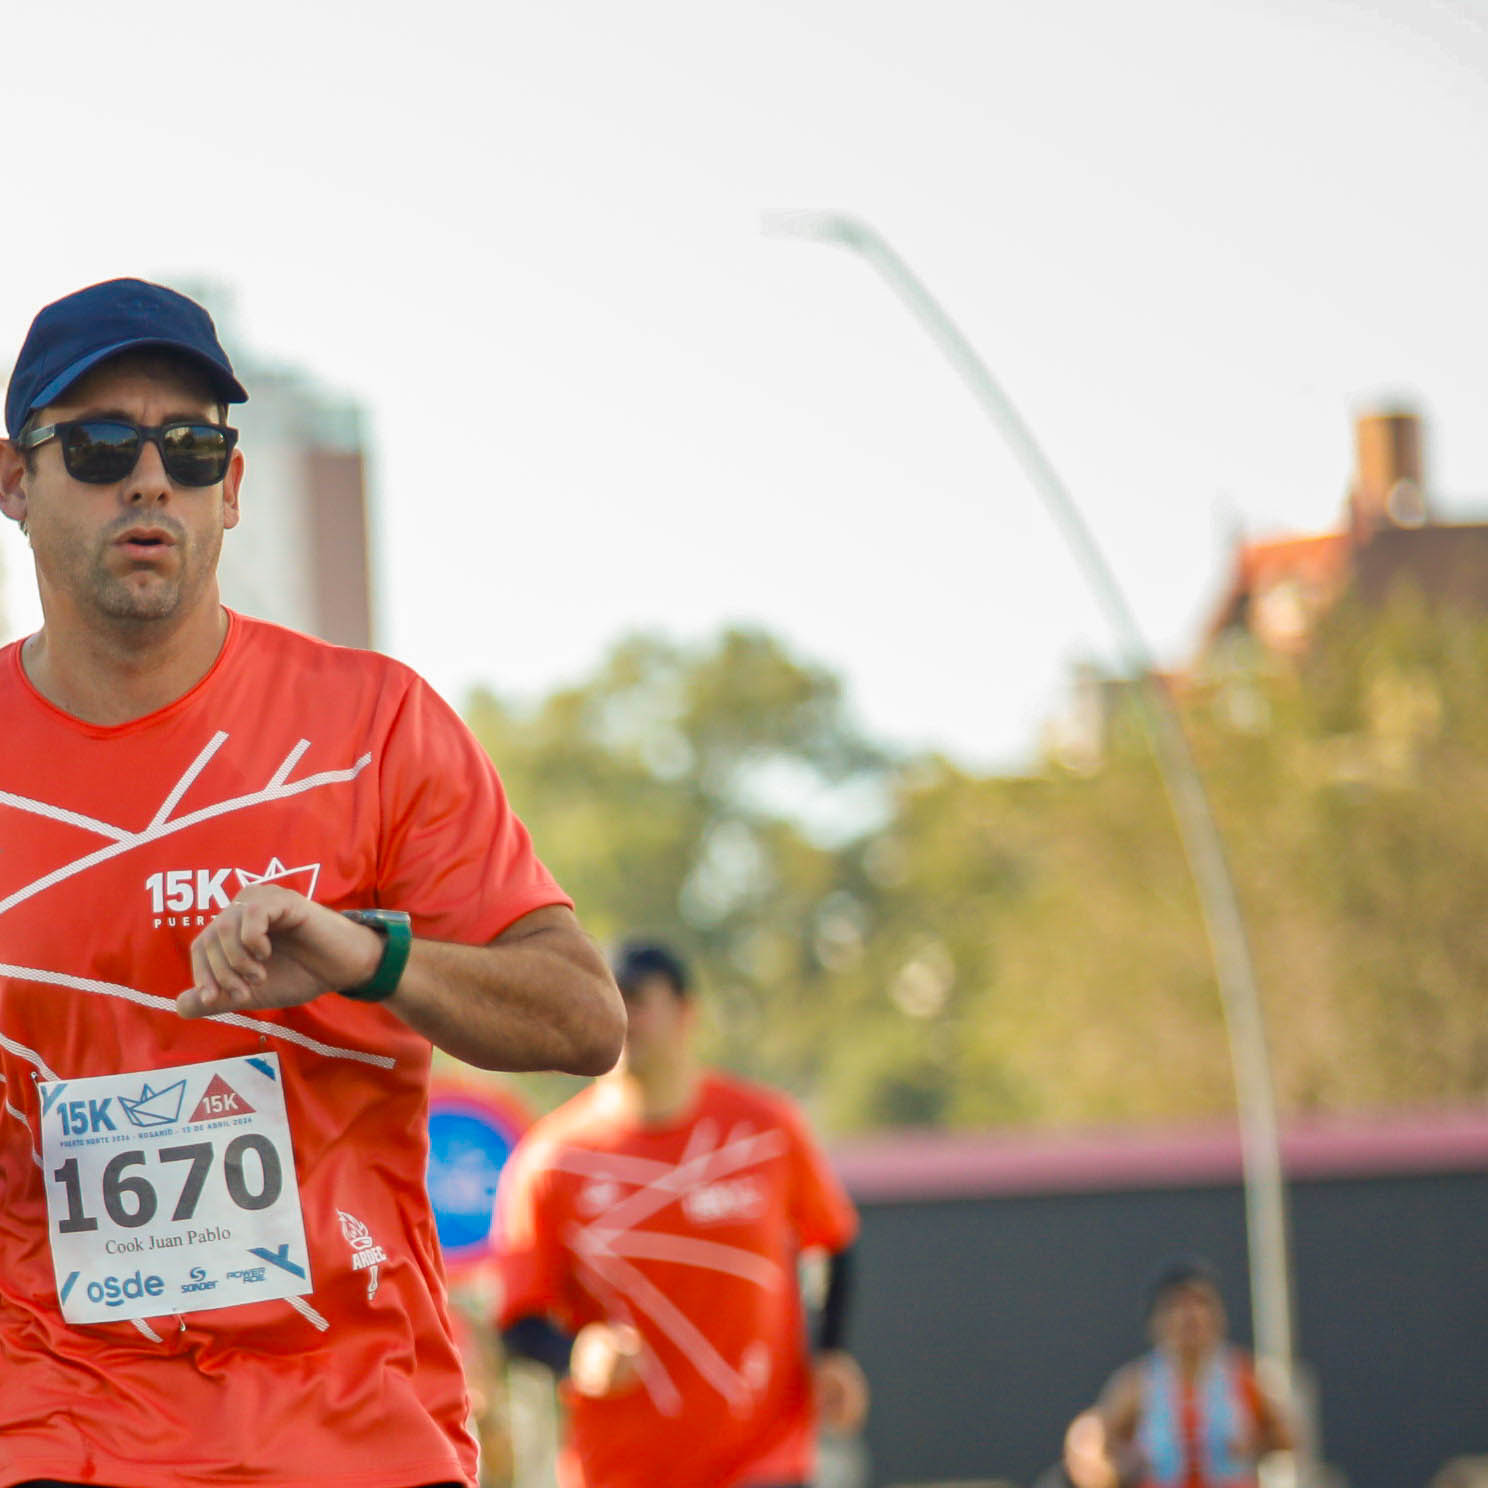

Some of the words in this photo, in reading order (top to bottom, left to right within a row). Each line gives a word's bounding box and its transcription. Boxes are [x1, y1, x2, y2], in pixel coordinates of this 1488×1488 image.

[145, 868, 233, 913] 15K
[154, 914, 218, 928] PUER
[56, 1098, 117, 1136] 15K
[201, 1092, 239, 1114] 15K
[53, 1133, 283, 1234] 1670
[105, 1237, 143, 1255] Cook
[148, 1235, 183, 1250] Juan
[188, 1226, 231, 1245] Pablo
[87, 1270, 165, 1307] osde
